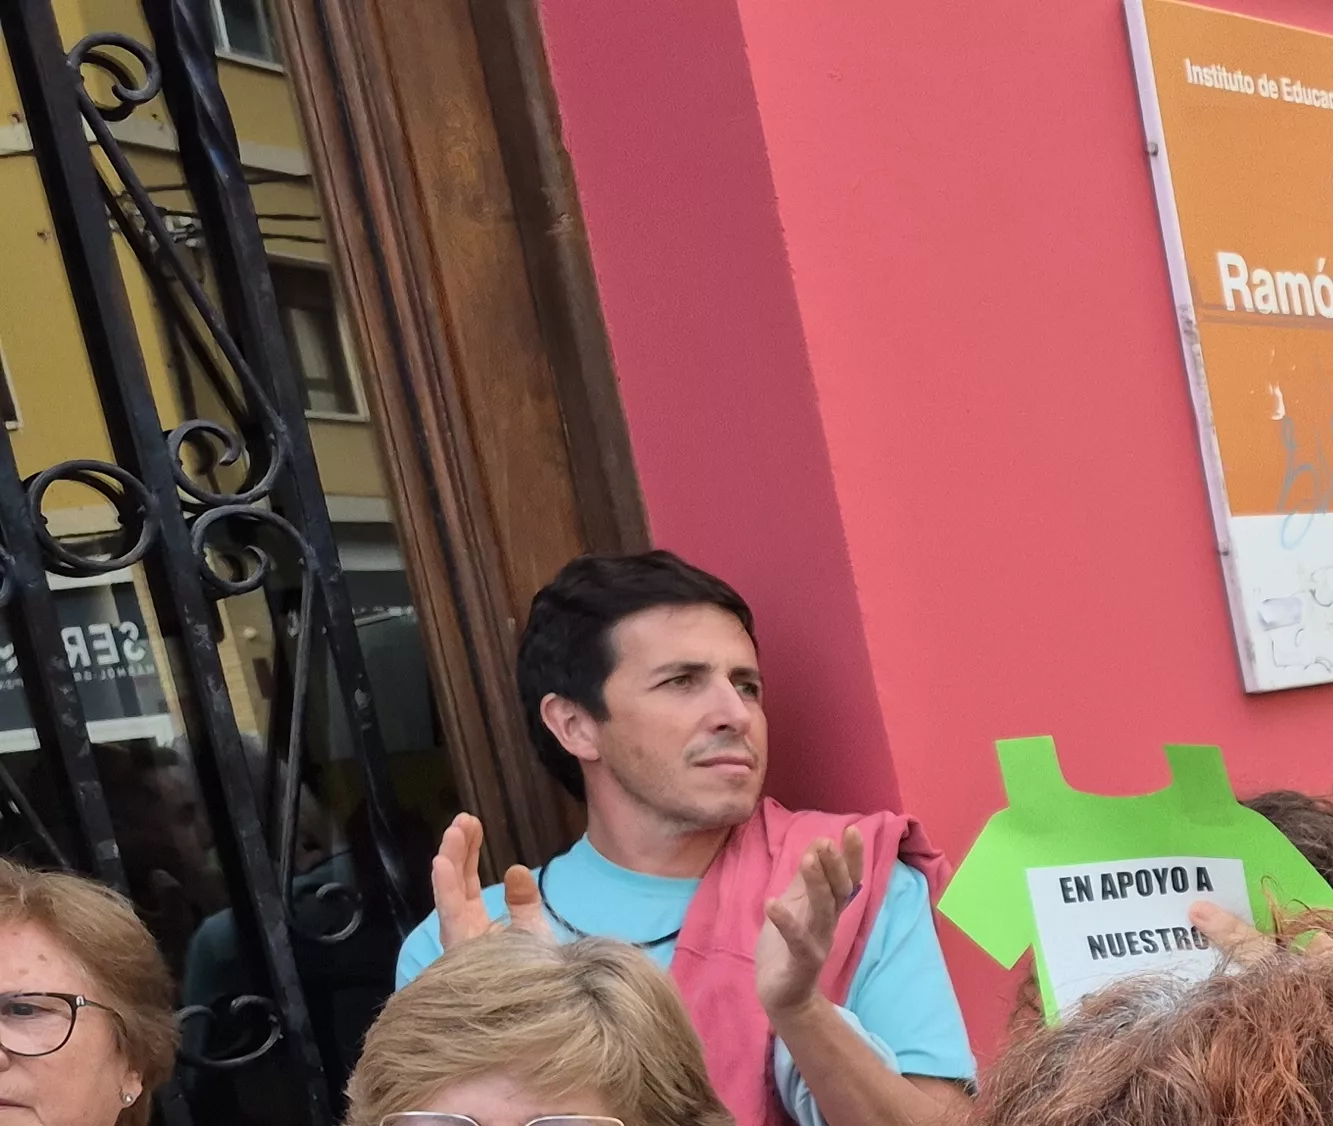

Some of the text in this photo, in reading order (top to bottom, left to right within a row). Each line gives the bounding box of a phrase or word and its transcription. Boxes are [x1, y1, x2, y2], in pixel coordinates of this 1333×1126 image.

[1184, 58, 1254, 95] Instituto
[1258, 73, 1280, 99] de
[1059, 866, 1214, 904] EN APOYO A
[1087, 926, 1210, 960] NUESTRO
